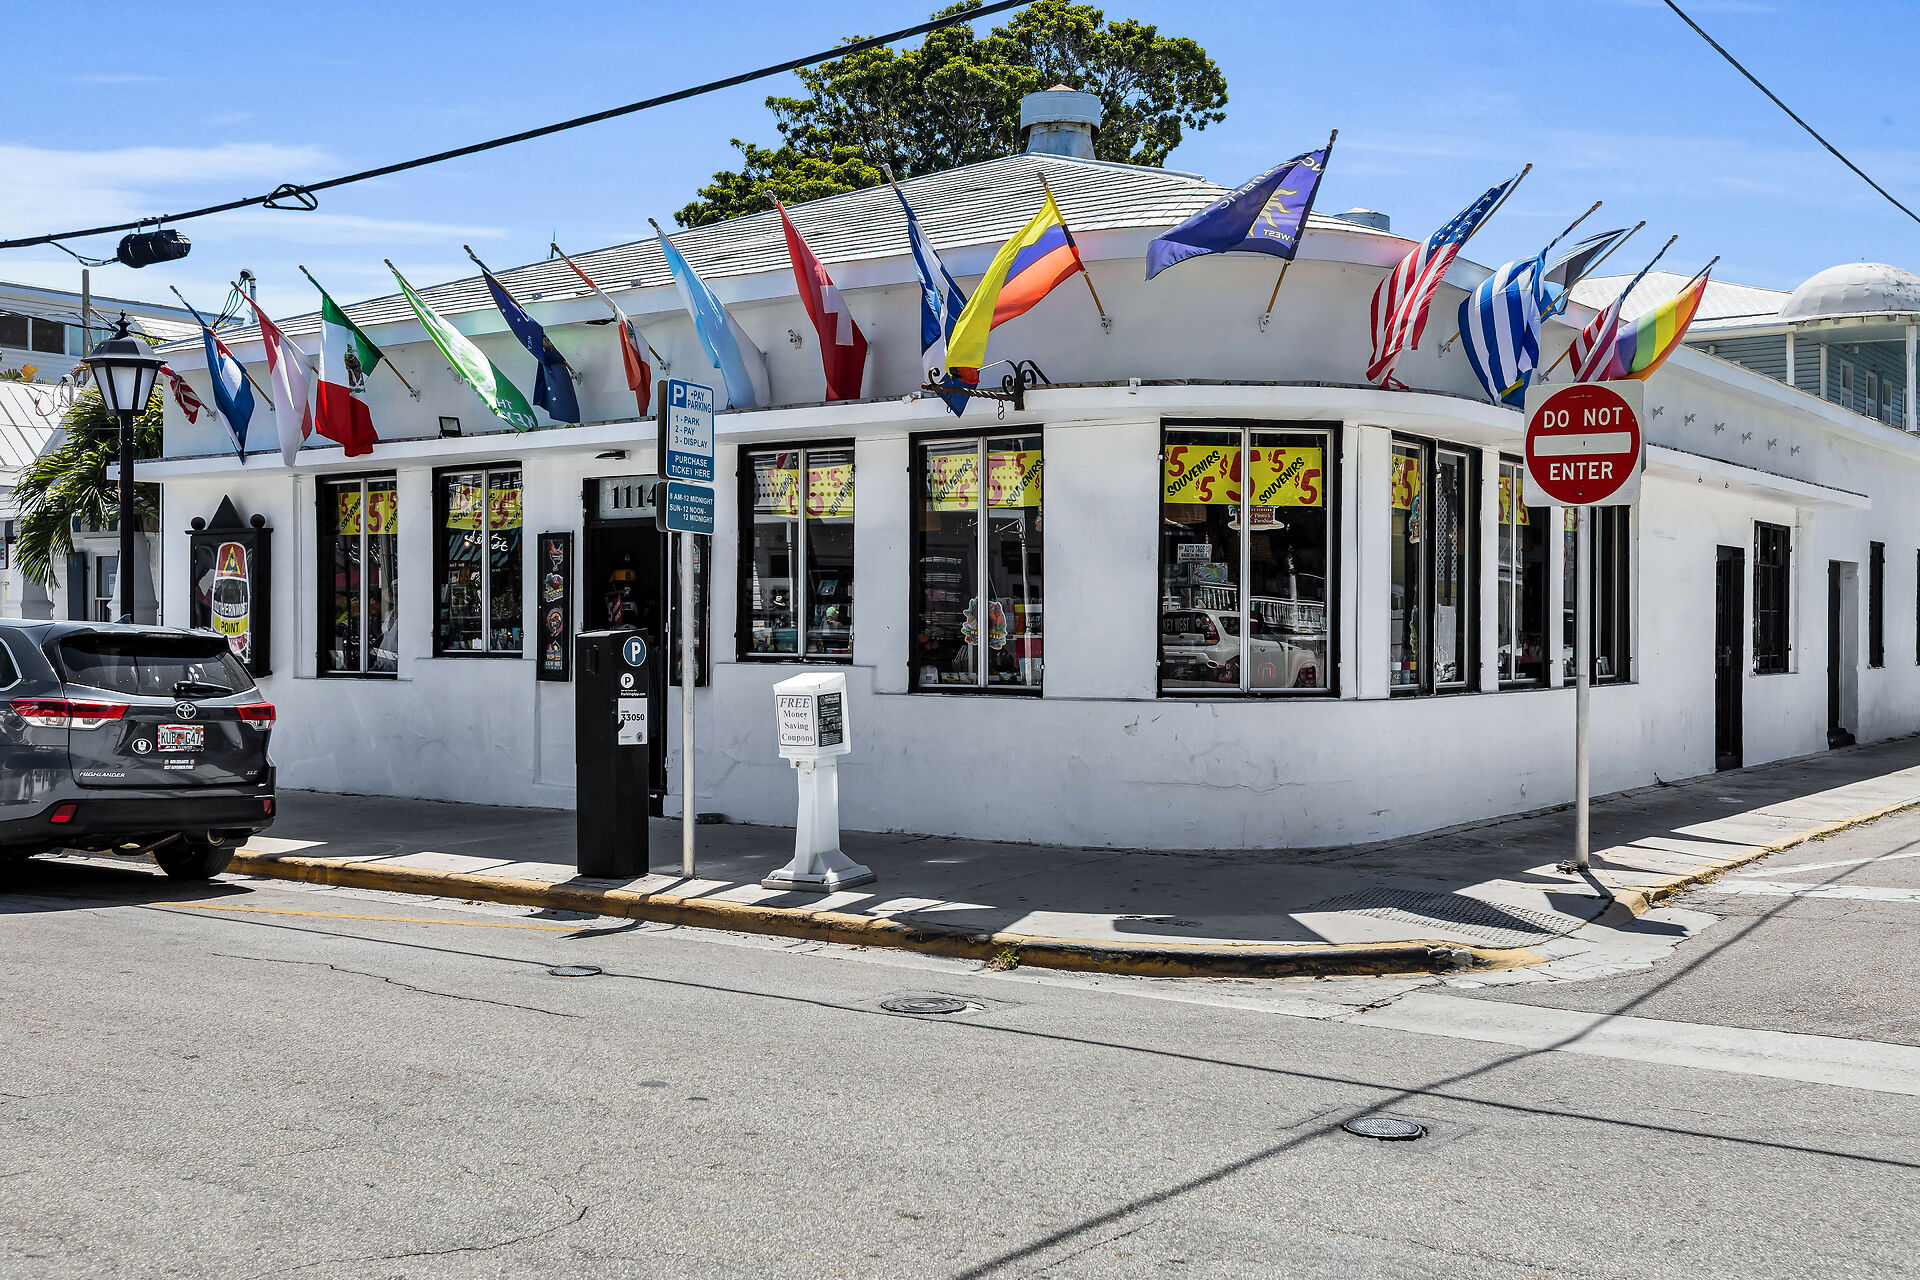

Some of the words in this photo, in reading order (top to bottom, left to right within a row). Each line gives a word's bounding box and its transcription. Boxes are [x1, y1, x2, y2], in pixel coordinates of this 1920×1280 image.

[673, 384, 684, 404] P
[694, 390, 704, 402] PAY
[687, 400, 712, 414] PARKING
[684, 416, 700, 426] PARK
[1543, 409, 1570, 428] DO
[1583, 406, 1624, 426] NOT
[684, 427, 695, 436] PAY
[684, 438, 708, 448] DISPLAY
[674, 455, 708, 468] PURCHASE
[1165, 446, 1188, 477] $5
[1268, 449, 1286, 472] $5
[672, 465, 693, 476] TICKET
[694, 468, 711, 478] HERE
[1167, 450, 1220, 496] SOUVENIRS
[1549, 461, 1613, 481] ENTER
[936, 459, 973, 504] SOUVENIRS
[1006, 459, 1043, 507] SOUVENIRS
[1259, 457, 1304, 504] SOUVENIRS
[1294, 469, 1320, 504] $5
[1196, 476, 1216, 502] $5
[612, 484, 656, 509] 1114
[690, 496, 713, 505] MIDNIGHT
[690, 514, 712, 523] MIDNIGHT
[221, 621, 240, 633] POINT
[1175, 618, 1189, 632] WEST
[780, 698, 810, 708] FREE
[784, 710, 808, 720] Money
[784, 722, 808, 731] Saving
[782, 733, 813, 743] Coupons
